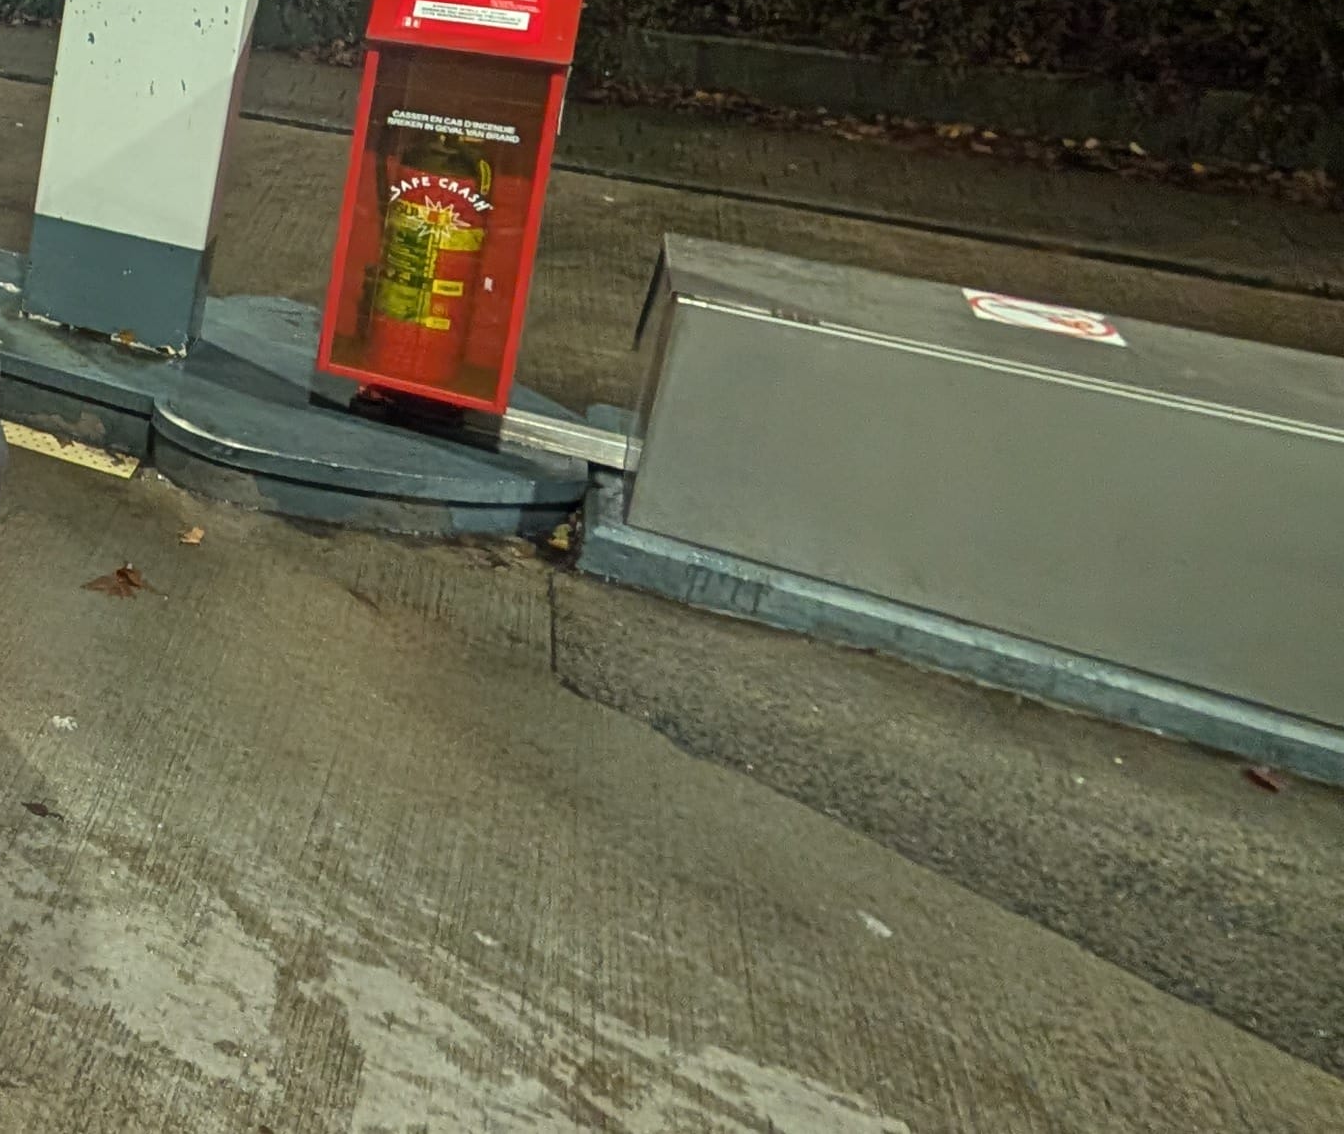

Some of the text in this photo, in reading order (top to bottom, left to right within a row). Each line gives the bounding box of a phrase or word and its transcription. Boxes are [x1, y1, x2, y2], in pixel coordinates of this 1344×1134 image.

[392, 109, 429, 122] CASSER
[430, 114, 443, 124] EN
[444, 116, 463, 127] CAS
[424, 122, 434, 131] IN
[434, 124, 464, 136] GEVAL
[465, 128, 485, 138] VAN
[485, 131, 520, 144] BRAND
[390, 176, 431, 202] SAFE
[438, 177, 490, 212] CRASH
